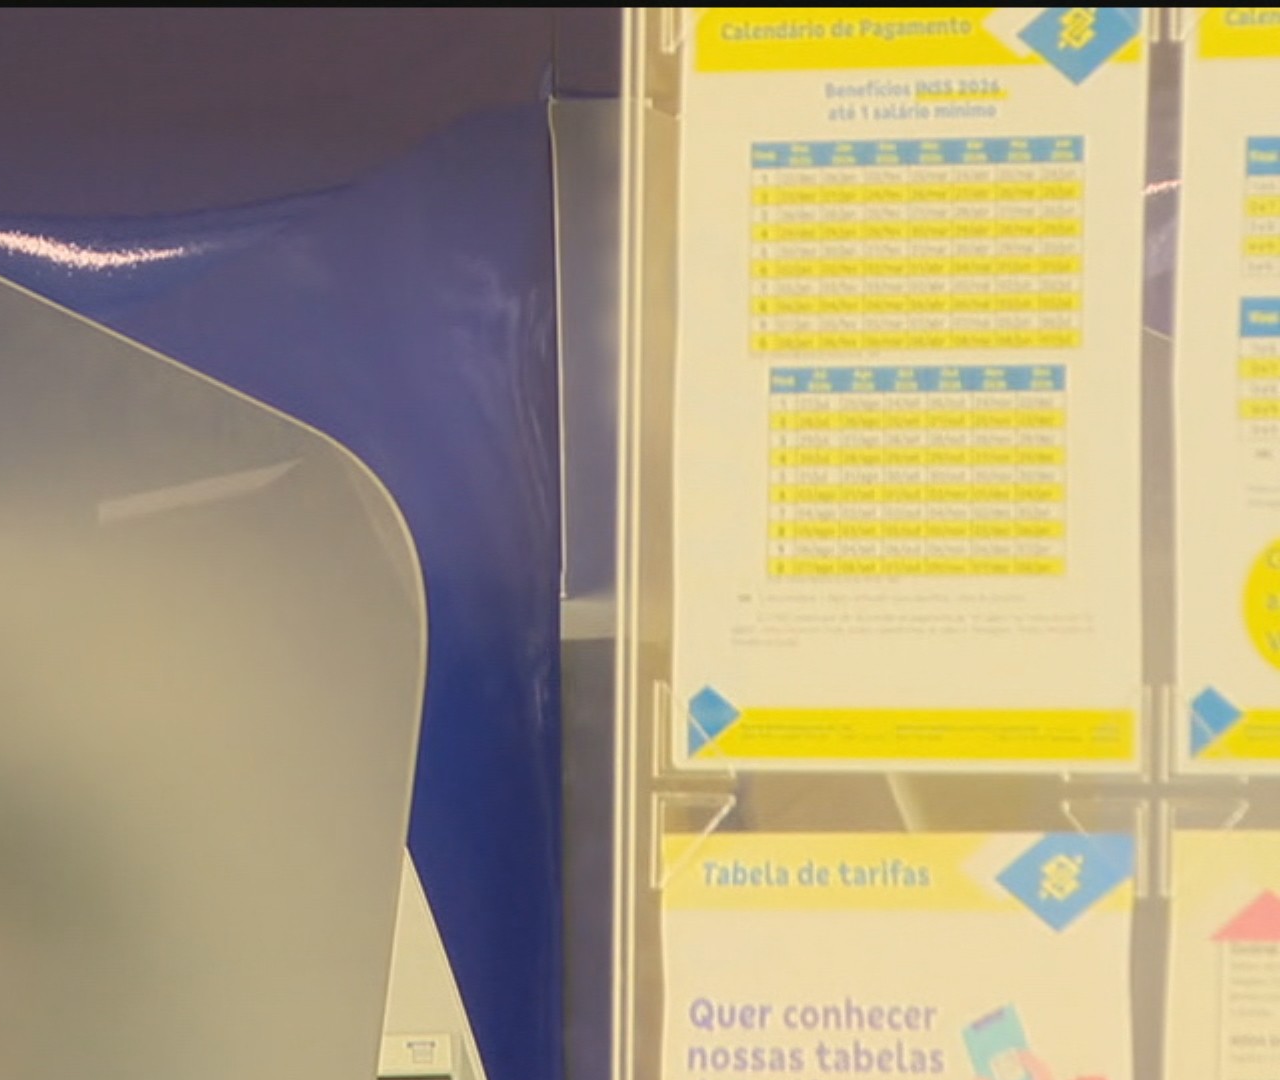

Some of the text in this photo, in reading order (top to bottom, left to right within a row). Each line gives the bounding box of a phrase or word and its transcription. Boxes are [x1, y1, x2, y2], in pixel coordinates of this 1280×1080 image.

[721, 17, 972, 40] Calendário de Pagamento
[825, 79, 1001, 98] Benefícios INSS 2026
[828, 103, 855, 120] até
[873, 103, 930, 120] salário
[703, 859, 930, 887] Tabela de tarifas
[689, 997, 937, 1031] Quer conhecer
[688, 1040, 944, 1073] nossas tabelas
